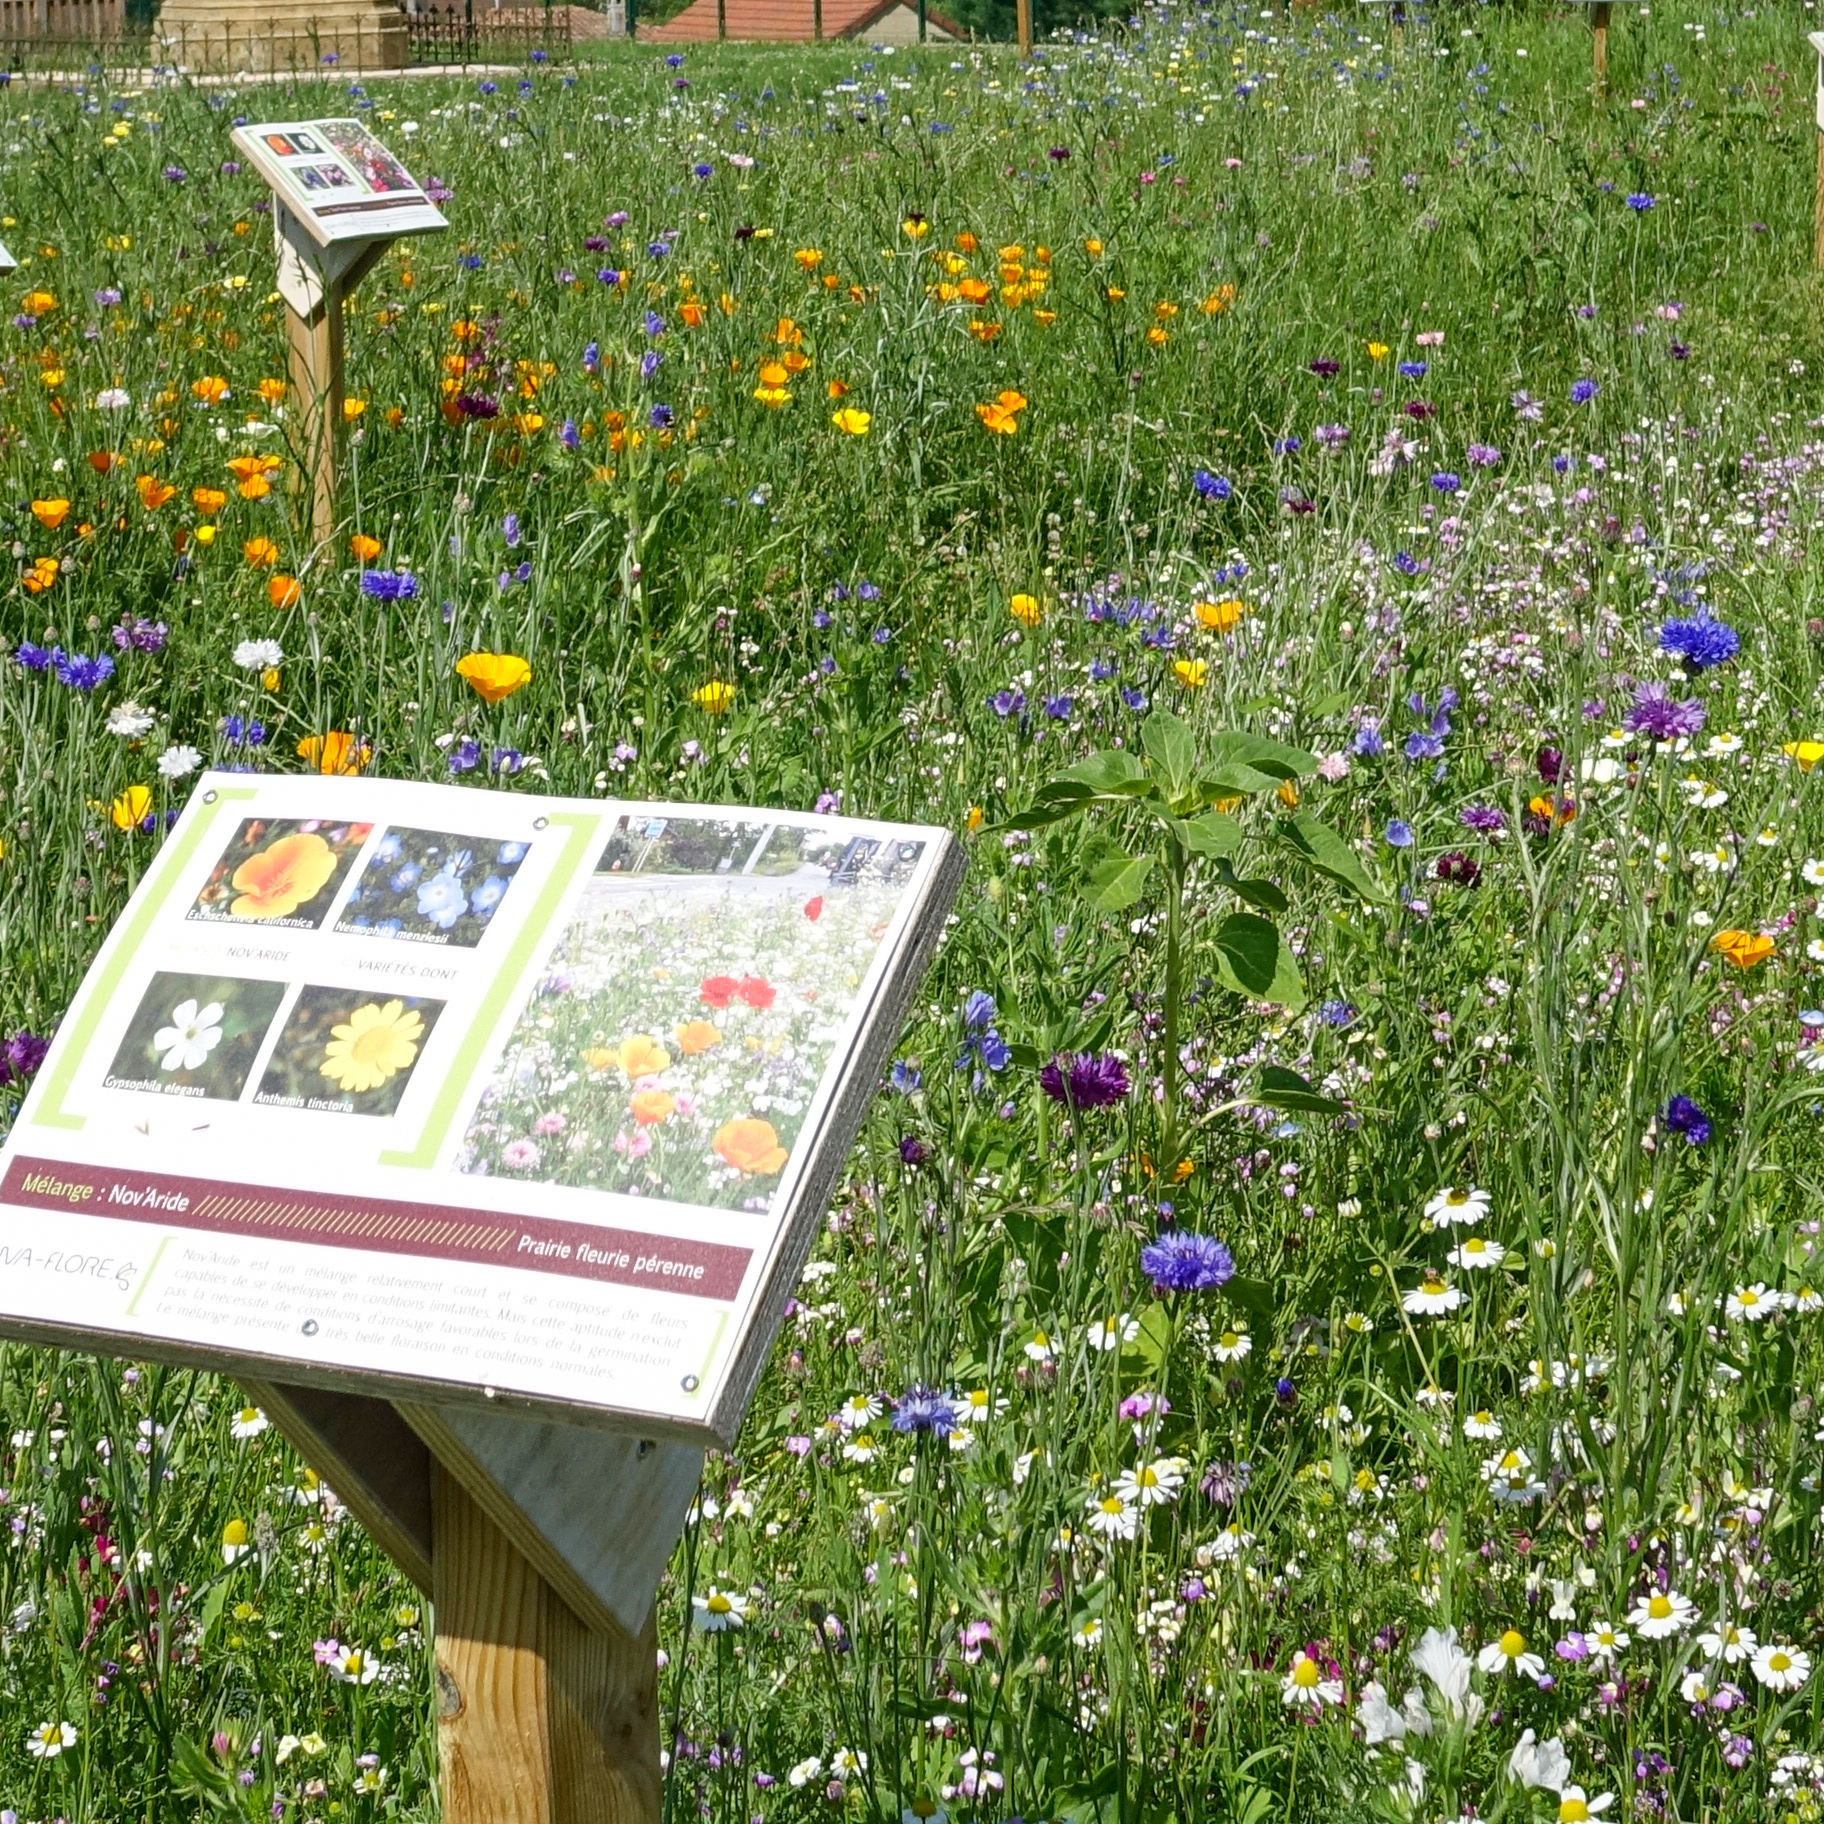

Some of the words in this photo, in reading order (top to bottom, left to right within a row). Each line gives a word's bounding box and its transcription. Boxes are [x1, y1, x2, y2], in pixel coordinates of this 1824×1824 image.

[420, 967, 459, 980] DONT
[105, 1075, 162, 1093] Gypsophila
[164, 1082, 205, 1097] elegans
[254, 1091, 304, 1108] Anthemis
[307, 1097, 354, 1114] tinctoria
[21, 1171, 94, 1202] Mélange
[108, 1184, 190, 1212] Nov'Aride
[517, 1234, 570, 1260] Prairie
[576, 1243, 630, 1268] fleurie
[632, 1255, 705, 1280] pérenne
[174, 1267, 227, 1285] capables
[232, 1274, 248, 1288] de
[253, 1279, 267, 1290] se
[270, 1281, 338, 1300] développer
[342, 1290, 358, 1302] en
[362, 1292, 425, 1311] conditions
[497, 1308, 526, 1324] Mais
[532, 1314, 566, 1331] cette
[570, 1319, 626, 1342] aptitude
[250, 1257, 269, 1272] est
[278, 1263, 295, 1276] un
[304, 1264, 358, 1284] mélange
[366, 1272, 444, 1294] relativement
[453, 1282, 488, 1299] court
[498, 1288, 511, 1302] et
[522, 1294, 538, 1306] se
[548, 1296, 611, 1318] compose
[621, 1307, 640, 1322] de
[650, 1311, 688, 1330] fleurs
[156, 1301, 172, 1314] Le
[176, 1304, 230, 1324] mélange
[234, 1314, 290, 1333] présente
[164, 1284, 187, 1298] pas
[194, 1287, 205, 1300] la
[211, 1290, 269, 1310] nécessité
[274, 1300, 292, 1313] de
[296, 1303, 361, 1323] conditions
[367, 1311, 434, 1334] d'arrosage
[439, 1320, 506, 1342] favorables
[512, 1330, 538, 1346] lors
[545, 1336, 564, 1350] de
[569, 1338, 582, 1354] la
[588, 1343, 671, 1368] germination
[325, 1326, 349, 1341] très
[355, 1329, 385, 1346] belle
[390, 1333, 446, 1353] floraison
[452, 1344, 469, 1356] en
[474, 1346, 544, 1368] conditions
